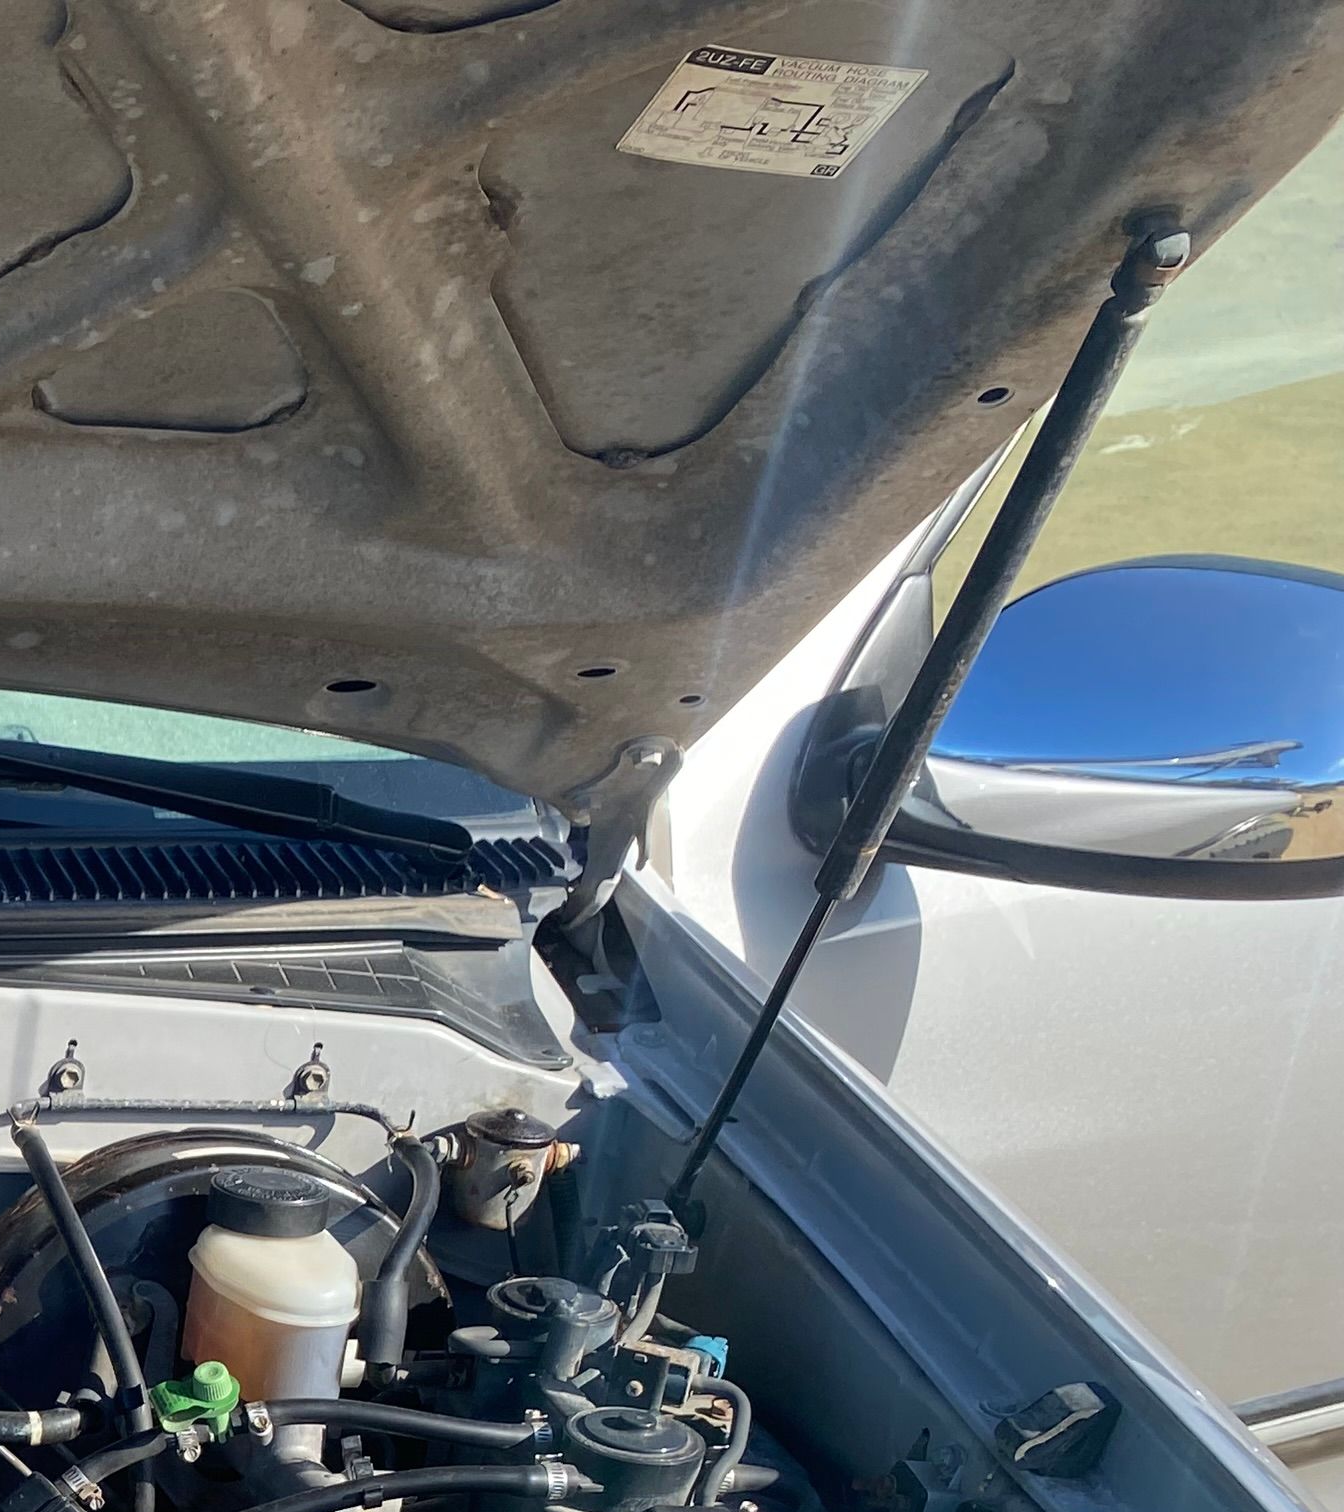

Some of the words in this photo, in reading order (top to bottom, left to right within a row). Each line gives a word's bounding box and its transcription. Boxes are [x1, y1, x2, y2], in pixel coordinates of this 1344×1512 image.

[696, 50, 767, 72] 2UZ-FE
[779, 59, 841, 74] VACUUM
[846, 65, 888, 78] HOSE
[771, 67, 837, 82] ROUTING
[844, 75, 910, 90] DIAGRAM
